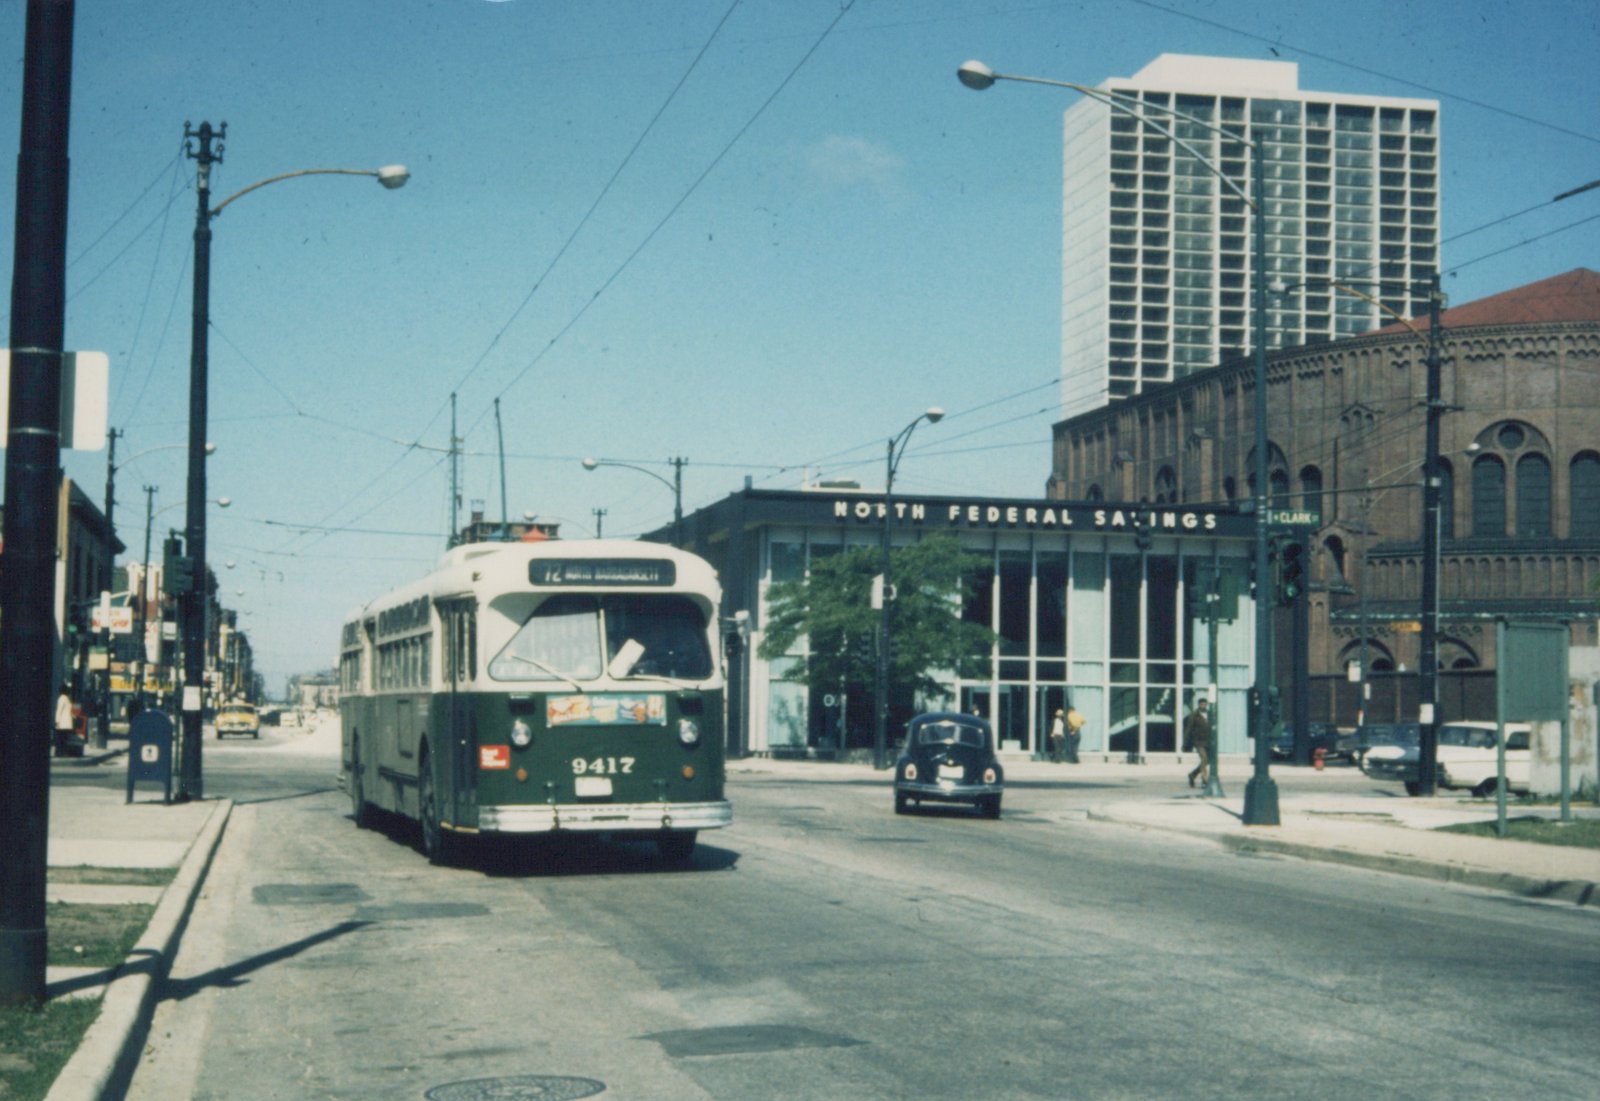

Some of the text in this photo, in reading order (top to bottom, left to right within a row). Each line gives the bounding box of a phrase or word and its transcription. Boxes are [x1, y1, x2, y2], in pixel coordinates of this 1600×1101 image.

[834, 501, 925, 520] NORTH
[949, 505, 1073, 525] FEDERAL
[1280, 512, 1311, 524] CLARK
[571, 756, 636, 774] 9417
